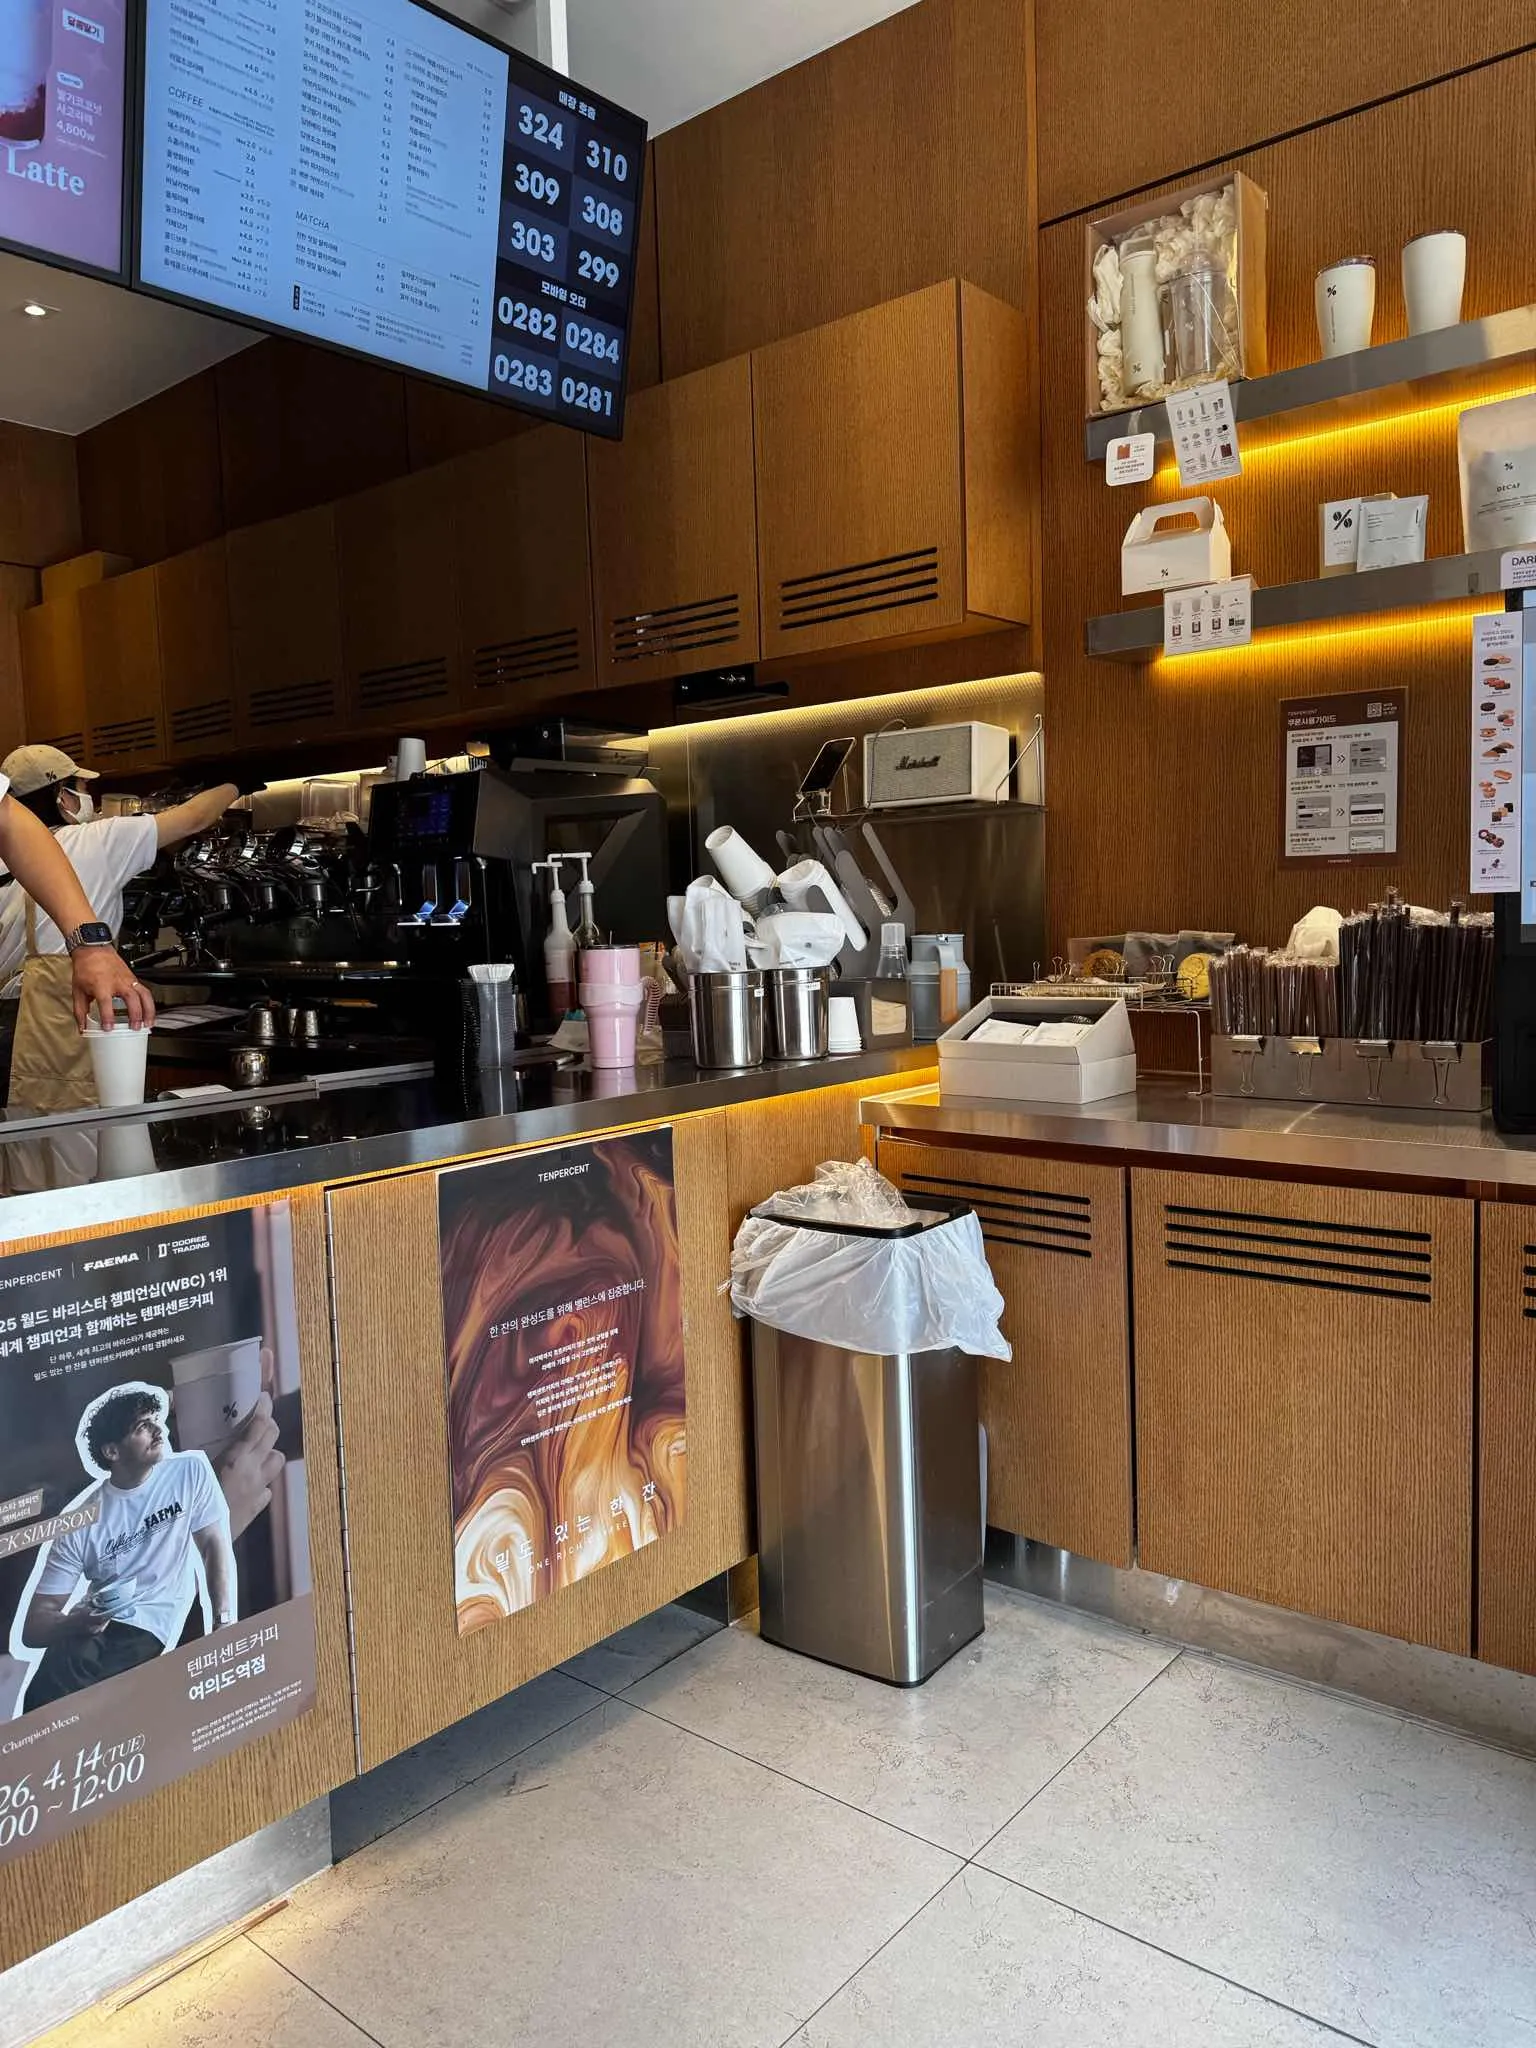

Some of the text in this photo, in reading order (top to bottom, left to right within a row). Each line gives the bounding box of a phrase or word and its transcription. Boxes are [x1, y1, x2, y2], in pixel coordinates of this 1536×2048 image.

[168, 86, 204, 107] COFFEE
[559, 91, 577, 110] 매장
[518, 105, 564, 150] 324
[7, 146, 85, 196] Latte
[586, 140, 628, 181] 310
[514, 163, 560, 205] 309
[295, 210, 330, 231] MATCHA
[582, 195, 623, 236] 308
[511, 221, 555, 263] 303
[577, 250, 620, 288] 299
[541, 280, 587, 309] 모바일 오더
[498, 296, 557, 342] 0282
[565, 322, 620, 364] 0284
[494, 354, 553, 396] 0283
[561, 377, 613, 416] 0281
[1512, 555, 1536, 566] DAR
[895, 755, 941, 771] Marshall
[538, 1163, 590, 1183] TENPERCENT
[171, 1235, 207, 1247] DOOREE
[172, 1241, 210, 1254] TRADING
[83, 1252, 139, 1271] FAEMA
[20, 1310, 50, 1329] 월드
[52, 1295, 107, 1320] 바리스타
[110, 1273, 205, 1308] 챔피언십(WBC)
[209, 1267, 228, 1283] 1위
[489, 1279, 647, 1338] 한 잔의 완성도를 위해 밸런스에 집중합니다.
[26, 1324, 83, 1350] 챔피언과
[85, 1312, 138, 1336] 함께하는
[140, 1290, 214, 1322] 텐퍼센트커피
[92, 1340, 111, 1353] 최고의
[113, 1331, 144, 1347] 바리스타가
[145, 1327, 169, 1339] 제공하는
[142, 1343, 154, 1353] 직접
[155, 1334, 185, 1348] 경험하세요
[22, 1506, 97, 1545] SIMPSON
[144, 1501, 183, 1530] FAEMA
[554, 1515, 592, 1544] 있는
[610, 1495, 623, 1517] 한
[642, 1481, 656, 1502] 잔
[528, 1558, 550, 1574] ONE
[556, 1543, 583, 1561] RICH
[187, 1623, 279, 1678] 텐퍼센트커피
[189, 1653, 266, 1700] 여의도역점
[2, 1713, 80, 1754] Champion Meets
[43, 1760, 66, 1790] 4.
[70, 1753, 145, 1813] 12:00
